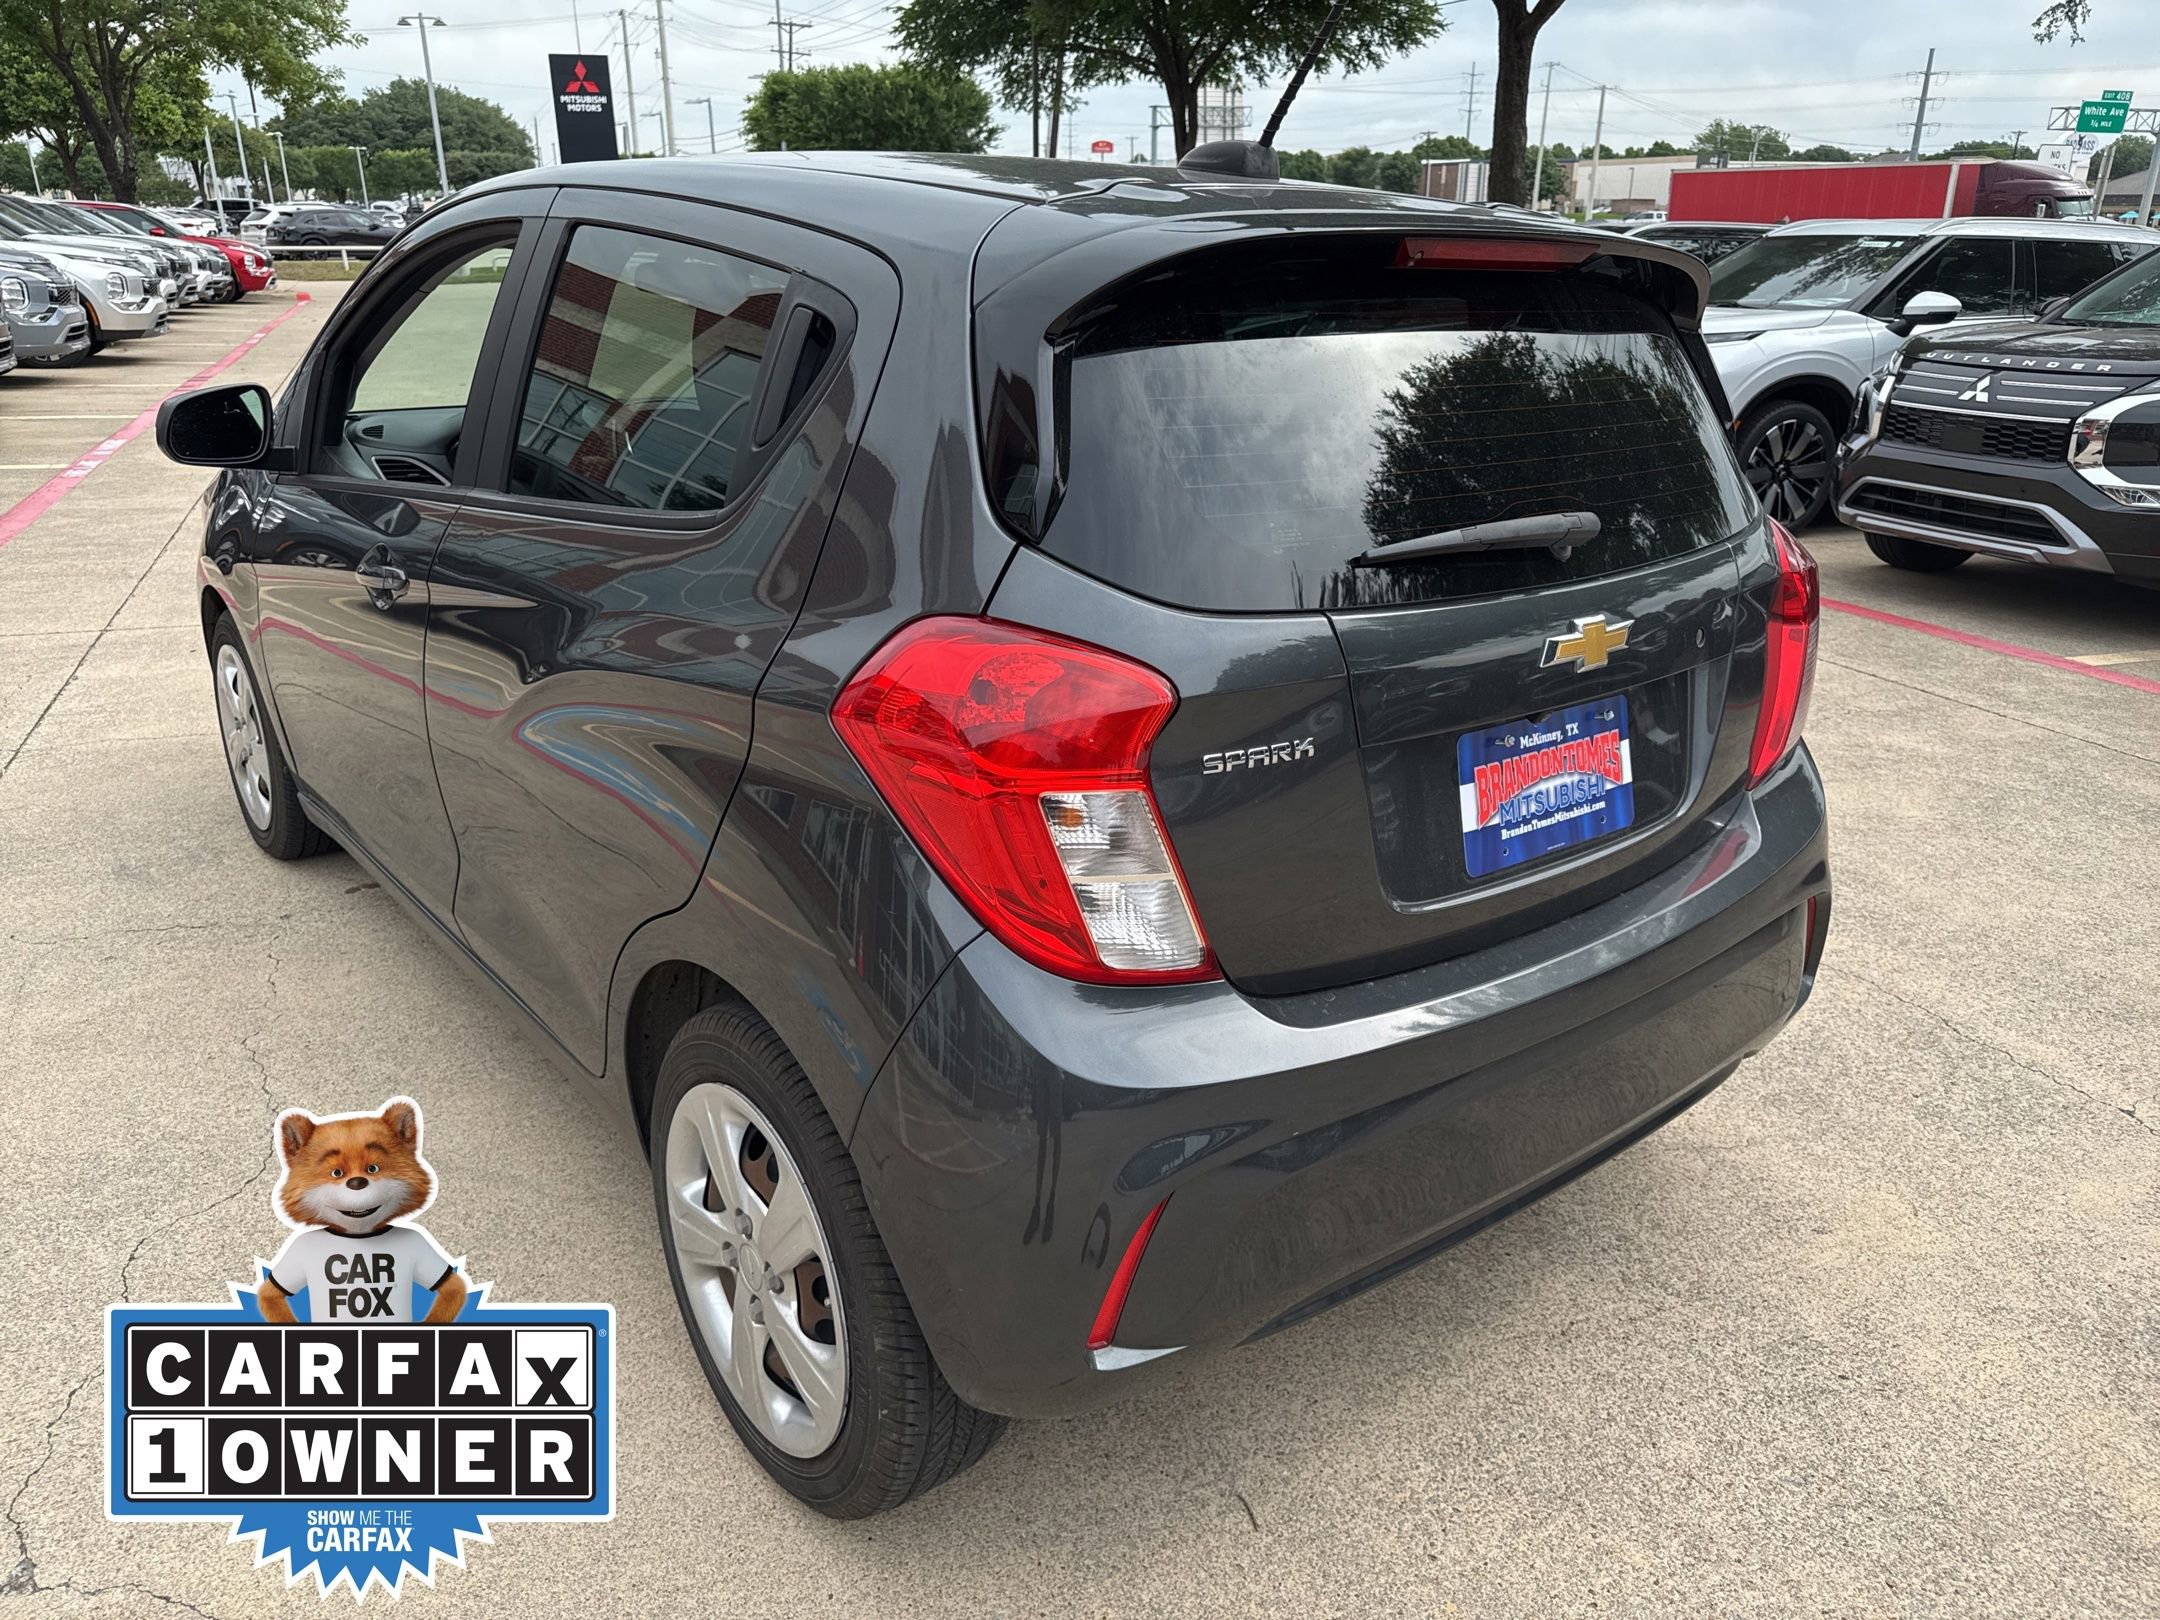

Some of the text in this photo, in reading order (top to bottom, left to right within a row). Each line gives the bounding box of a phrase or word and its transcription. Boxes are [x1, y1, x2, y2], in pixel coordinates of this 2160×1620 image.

[560, 95, 607, 104] MITSUBISHI
[2116, 92, 2130, 100] 40B
[567, 104, 602, 112] MOTORS
[2084, 106, 2124, 116] White Ave
[2050, 151, 2060, 159] NO
[1926, 352, 2112, 372] OUTLANDER
[1520, 723, 1579, 748] McKinney, TX
[1203, 737, 1315, 775] SPARK
[1500, 773, 1607, 826] MITSUBISHI
[1501, 801, 1606, 840] BrandonTomesMitsubishi.com
